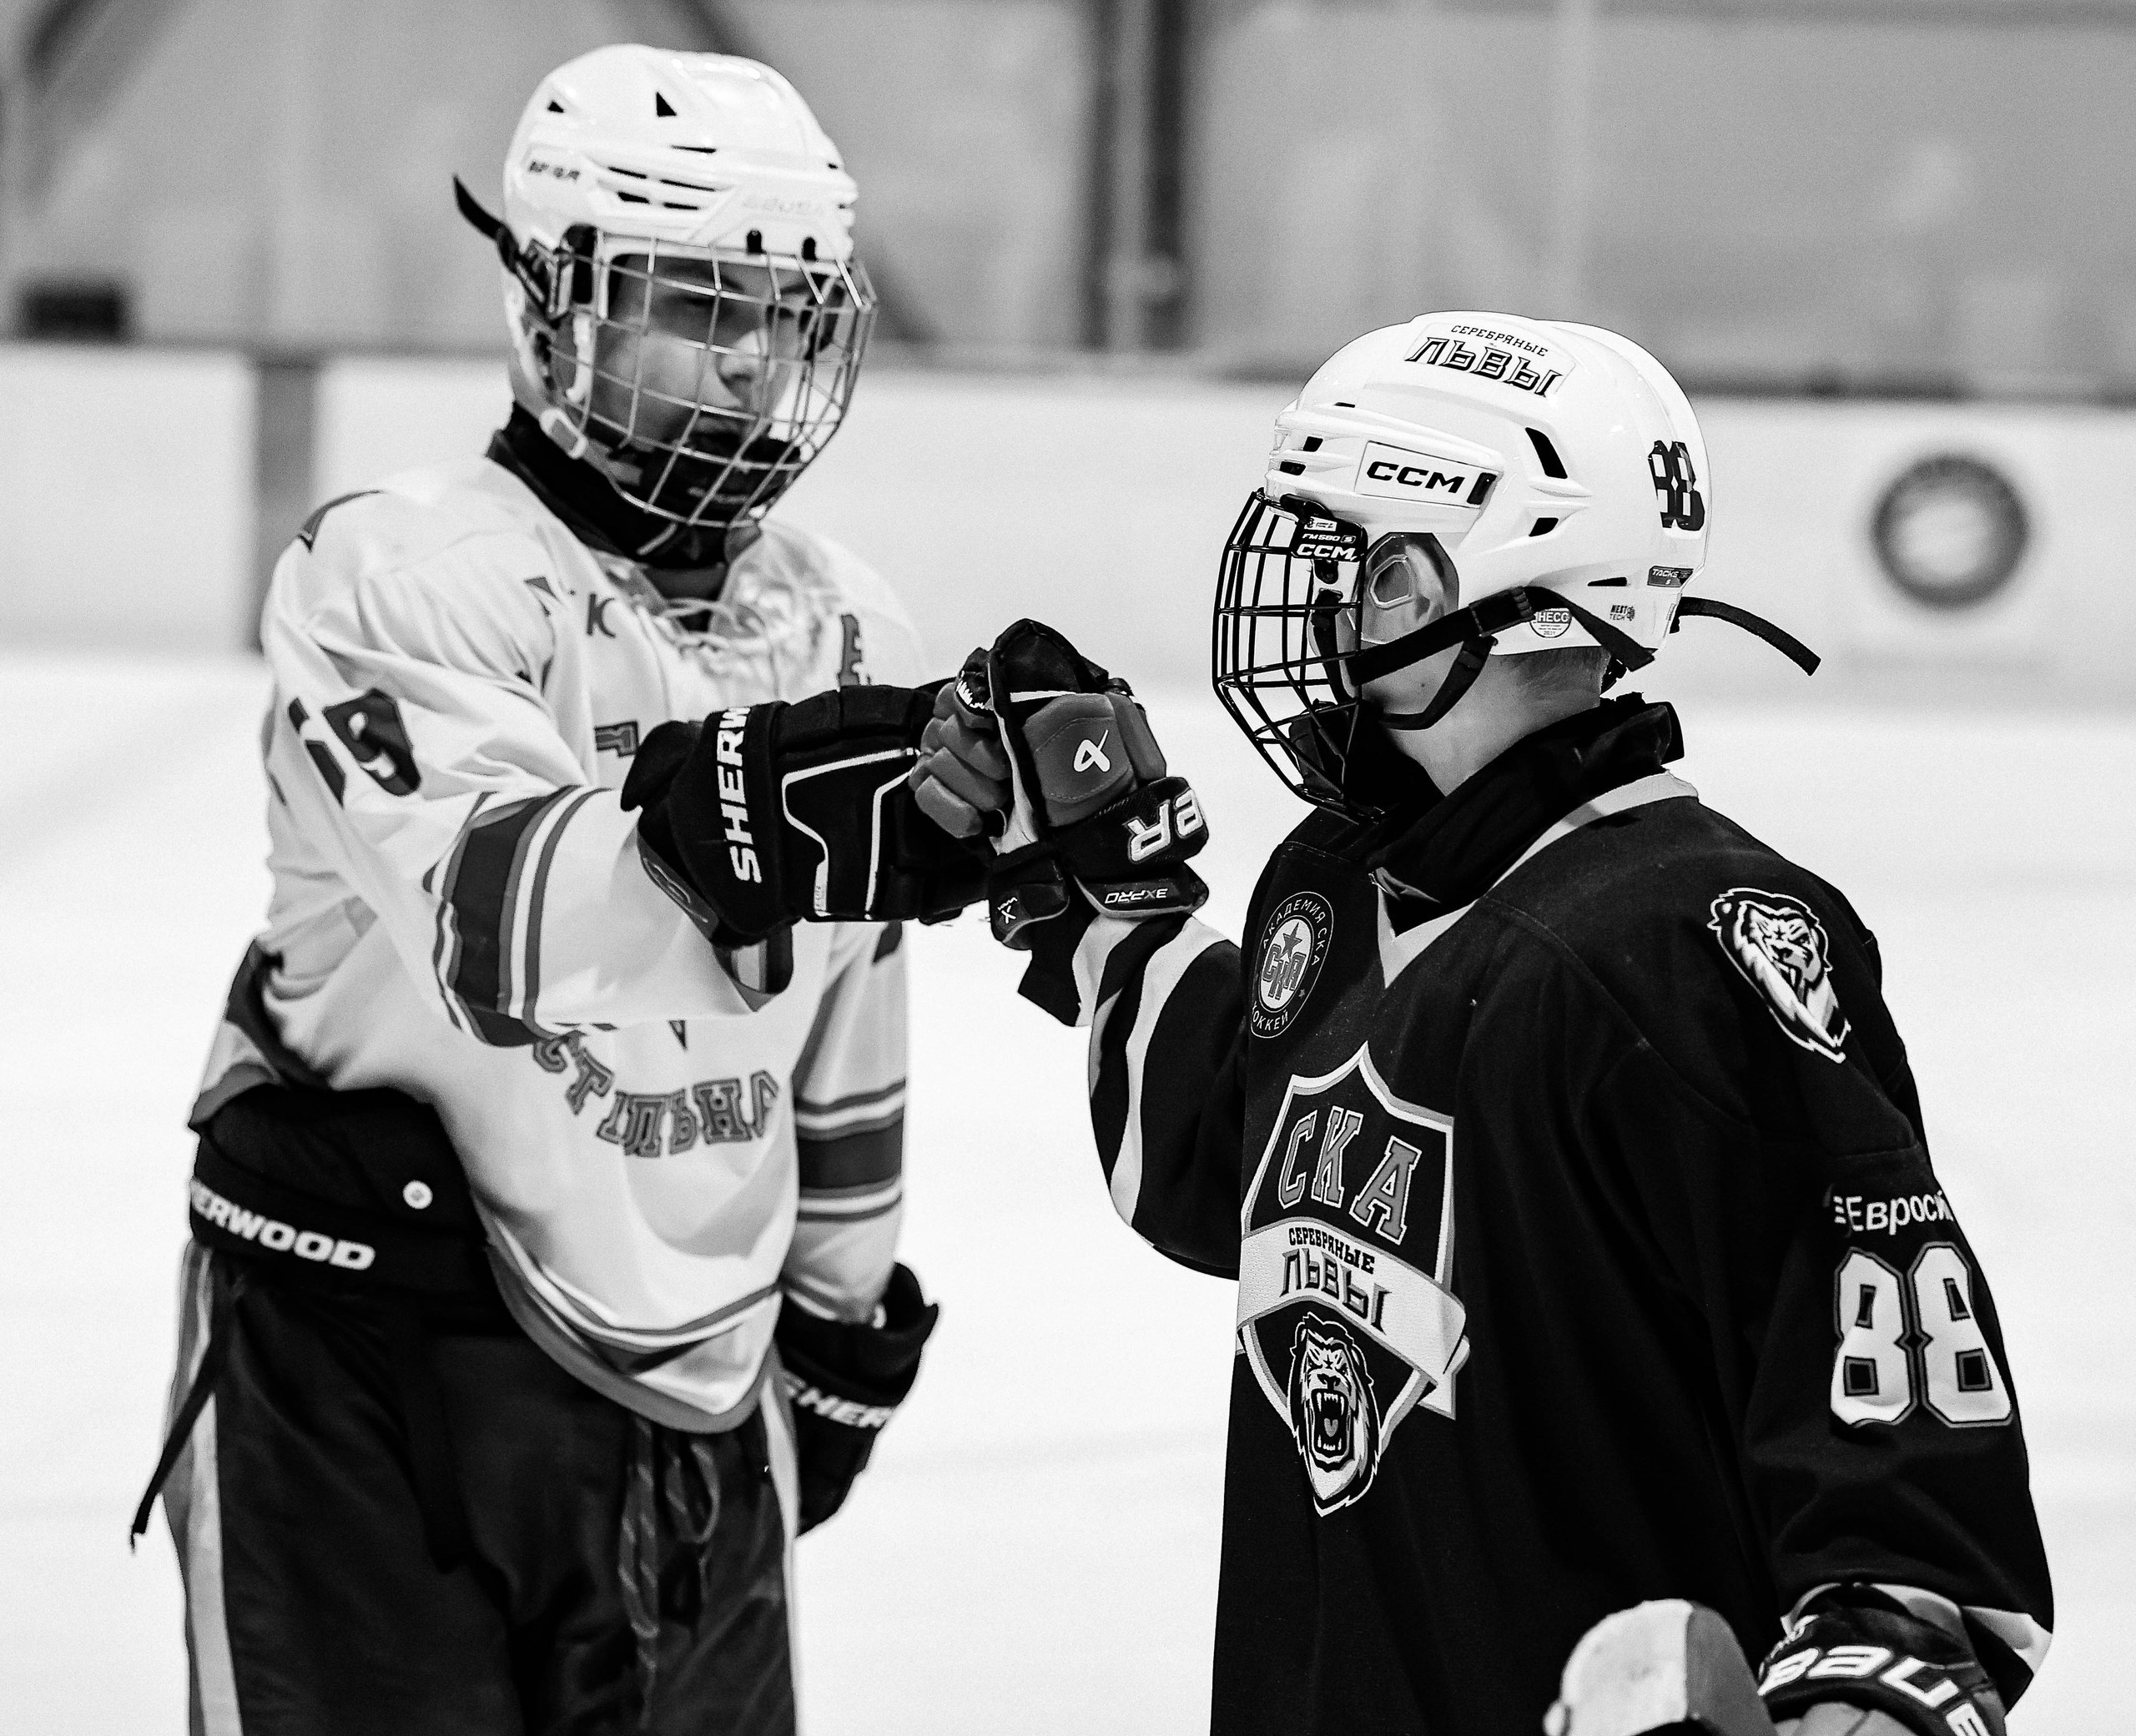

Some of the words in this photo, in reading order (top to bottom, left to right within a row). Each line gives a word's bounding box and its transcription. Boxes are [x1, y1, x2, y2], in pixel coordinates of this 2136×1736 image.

[1403, 336, 1563, 398] ЛЬВЫ
[1451, 325, 1549, 357] СЕРЕБРЯНЫЕ
[1367, 460, 1465, 494] CCM
[1297, 543, 1356, 560] CCM
[717, 707, 762, 883] SHERW
[1262, 898, 1327, 949] АКАДЕМИЯ
[1311, 927, 1327, 966] СКА
[1278, 1104, 1423, 1245] СКА
[1288, 1227, 1376, 1276] СЕРЕБРЯНЫЕ
[1279, 1248, 1393, 1336] ЛЬВЫ
[1830, 1240, 2013, 1429] 88
[1757, 1645, 1990, 1736] BAUE
